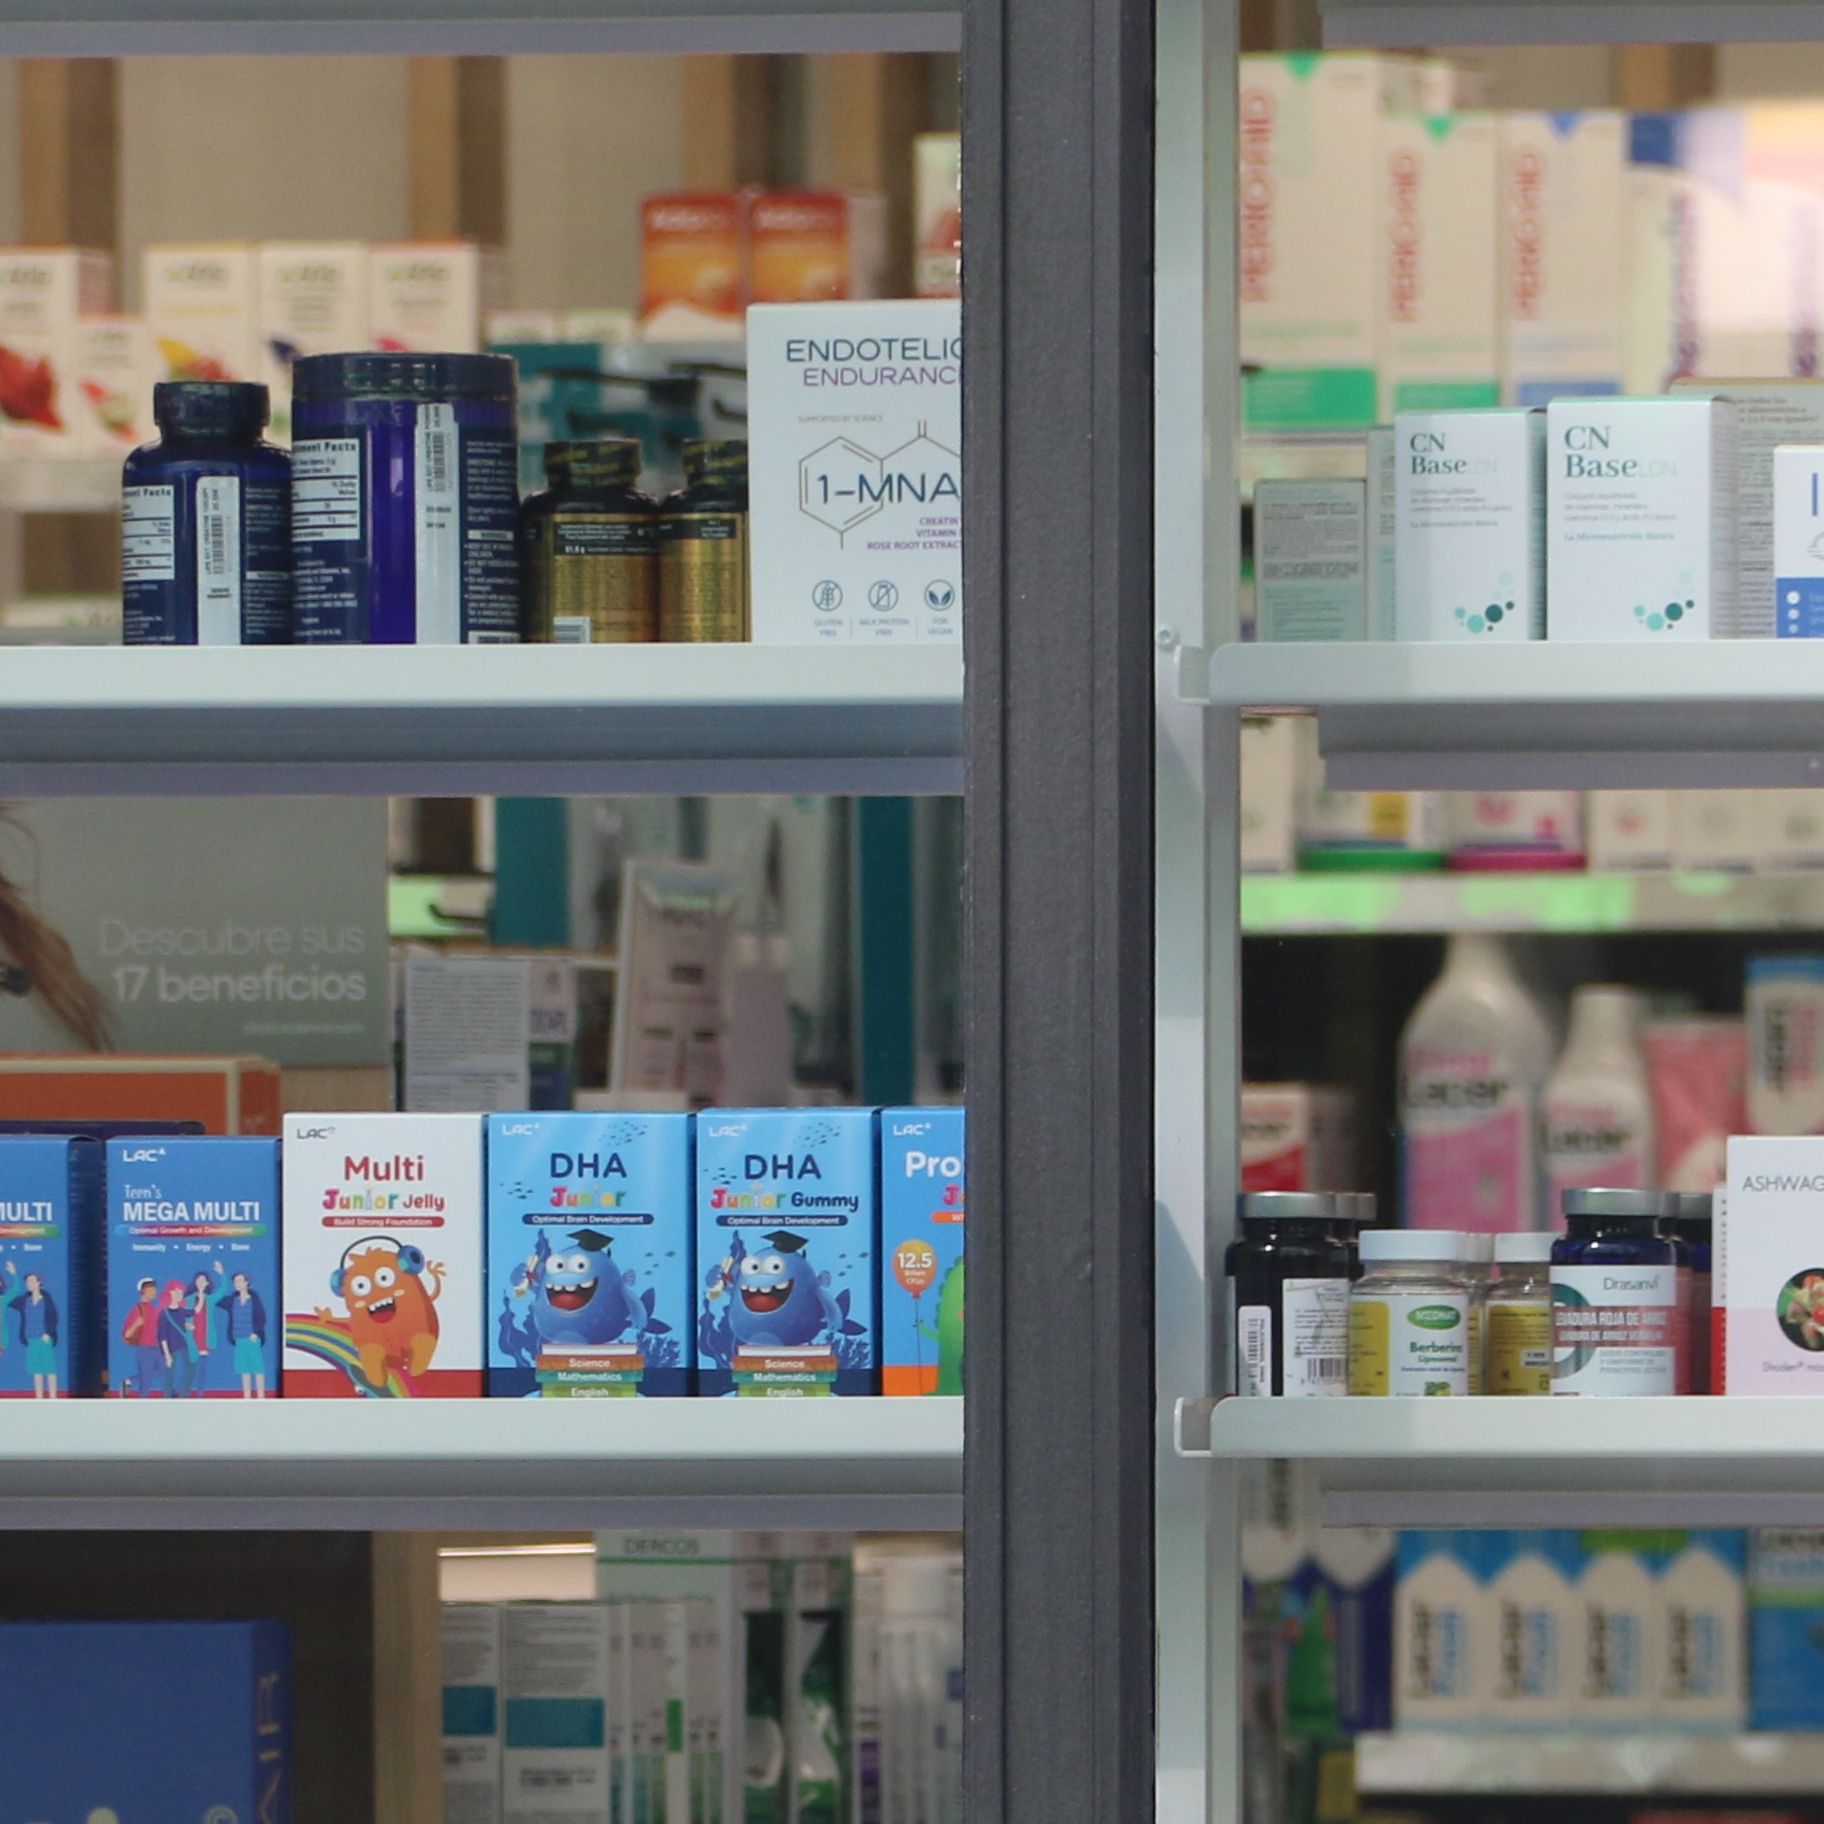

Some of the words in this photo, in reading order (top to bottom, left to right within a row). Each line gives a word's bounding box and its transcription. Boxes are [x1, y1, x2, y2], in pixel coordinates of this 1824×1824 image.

[803, 366, 961, 387] ENDURANC
[1409, 432, 1446, 453] CN
[1564, 425, 1611, 450] CN
[1410, 455, 1468, 475] Base
[1564, 453, 1638, 479] Base
[867, 542, 892, 550] ROSE
[894, 541, 920, 550] ROOT
[100, 920, 294, 958] Descubre
[304, 924, 365, 956] sus
[112, 969, 150, 1001] 17
[157, 966, 367, 1001] beneficios
[343, 1154, 425, 1182] Multi
[550, 1152, 628, 1179] DHA
[744, 1154, 822, 1180] DHA
[322, 1187, 399, 1211] Junior
[402, 1193, 445, 1212] Jelly
[550, 1184, 626, 1208] Junior
[710, 1184, 787, 1209] Junior
[791, 1192, 860, 1212] Gummy
[532, 1215, 564, 1225] Optimal
[566, 1215, 587, 1224] Brain
[589, 1215, 644, 1225] Development
[897, 1253, 932, 1269] 12.5
[569, 1358, 611, 1368] Science
[558, 1372, 622, 1381] Mathematics
